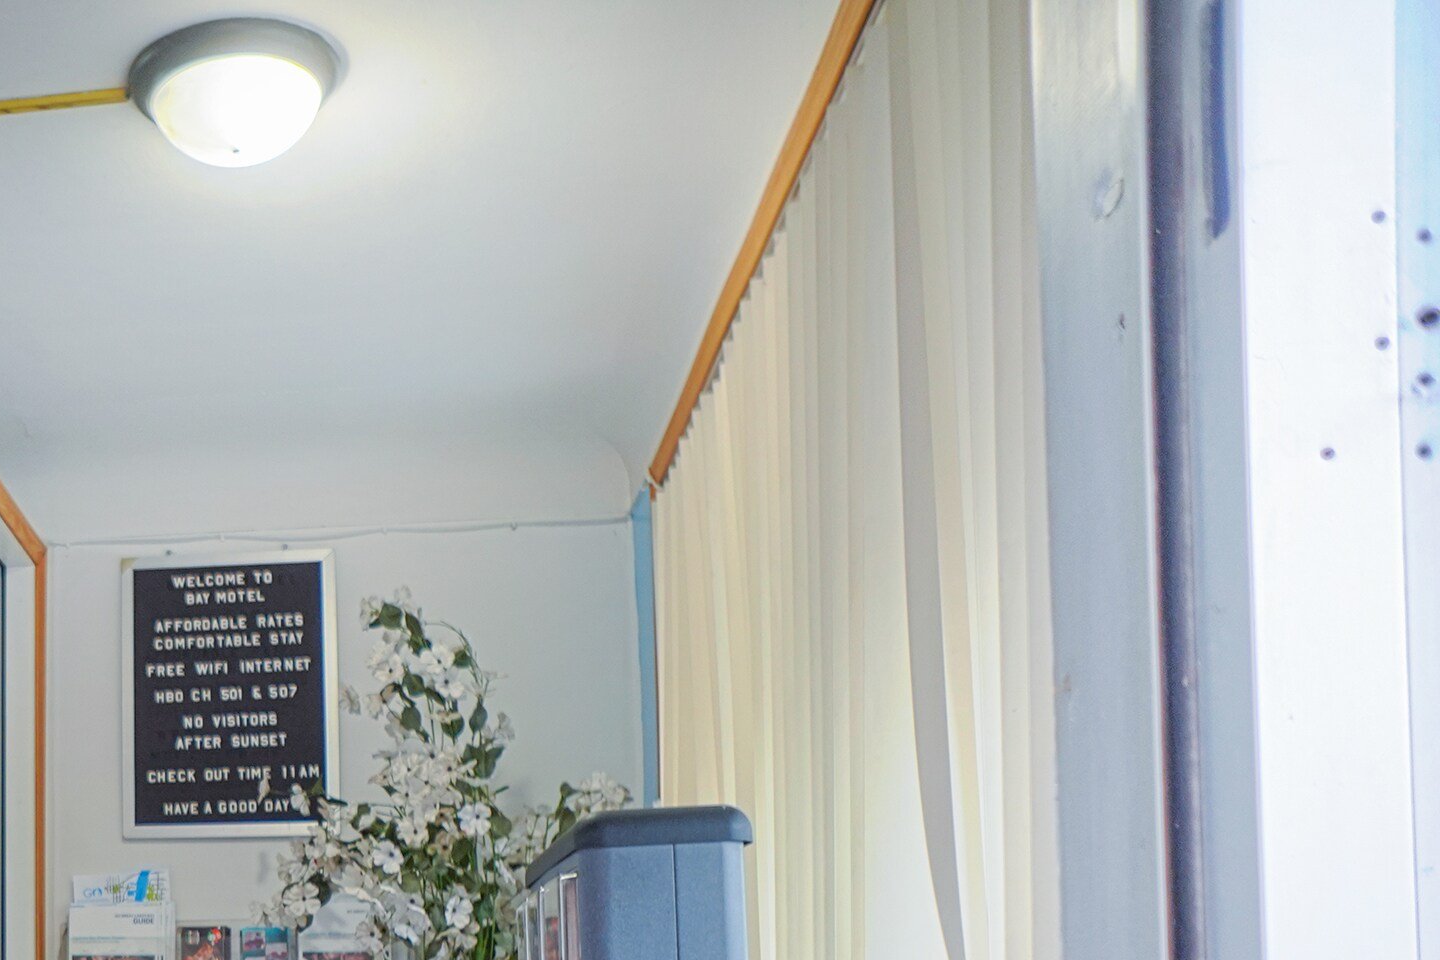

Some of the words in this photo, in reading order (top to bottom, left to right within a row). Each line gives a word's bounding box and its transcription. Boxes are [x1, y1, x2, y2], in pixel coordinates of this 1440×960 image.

[172, 573, 245, 588] WELCOME
[254, 571, 273, 585] TO
[186, 591, 210, 605] BAY
[216, 588, 265, 603] MOTEL
[155, 615, 247, 633] AFFORDABLE
[257, 613, 303, 628] RATES
[154, 633, 260, 650] COMFORTABLE
[270, 632, 304, 646] STAY
[146, 663, 185, 677] FREE
[195, 661, 228, 676] WIFI
[240, 657, 311, 674] INTERNET
[155, 688, 183, 703] HBO
[191, 688, 211, 702] CH
[220, 687, 242, 701] 501
[252, 686, 262, 700] &
[268, 684, 297, 699] 507
[183, 715, 203, 729] NO
[213, 712, 277, 728] VISITORS
[175, 736, 221, 750] AFTER
[231, 733, 287, 748] SUNSET
[147, 769, 196, 783] CHECK
[205, 768, 230, 782] OUT
[237, 766, 271, 780] TIME
[164, 802, 199, 816] HAVE
[204, 802, 212, 815] A
[218, 801, 257, 814] GOOD
[265, 799, 289, 813] DAY
